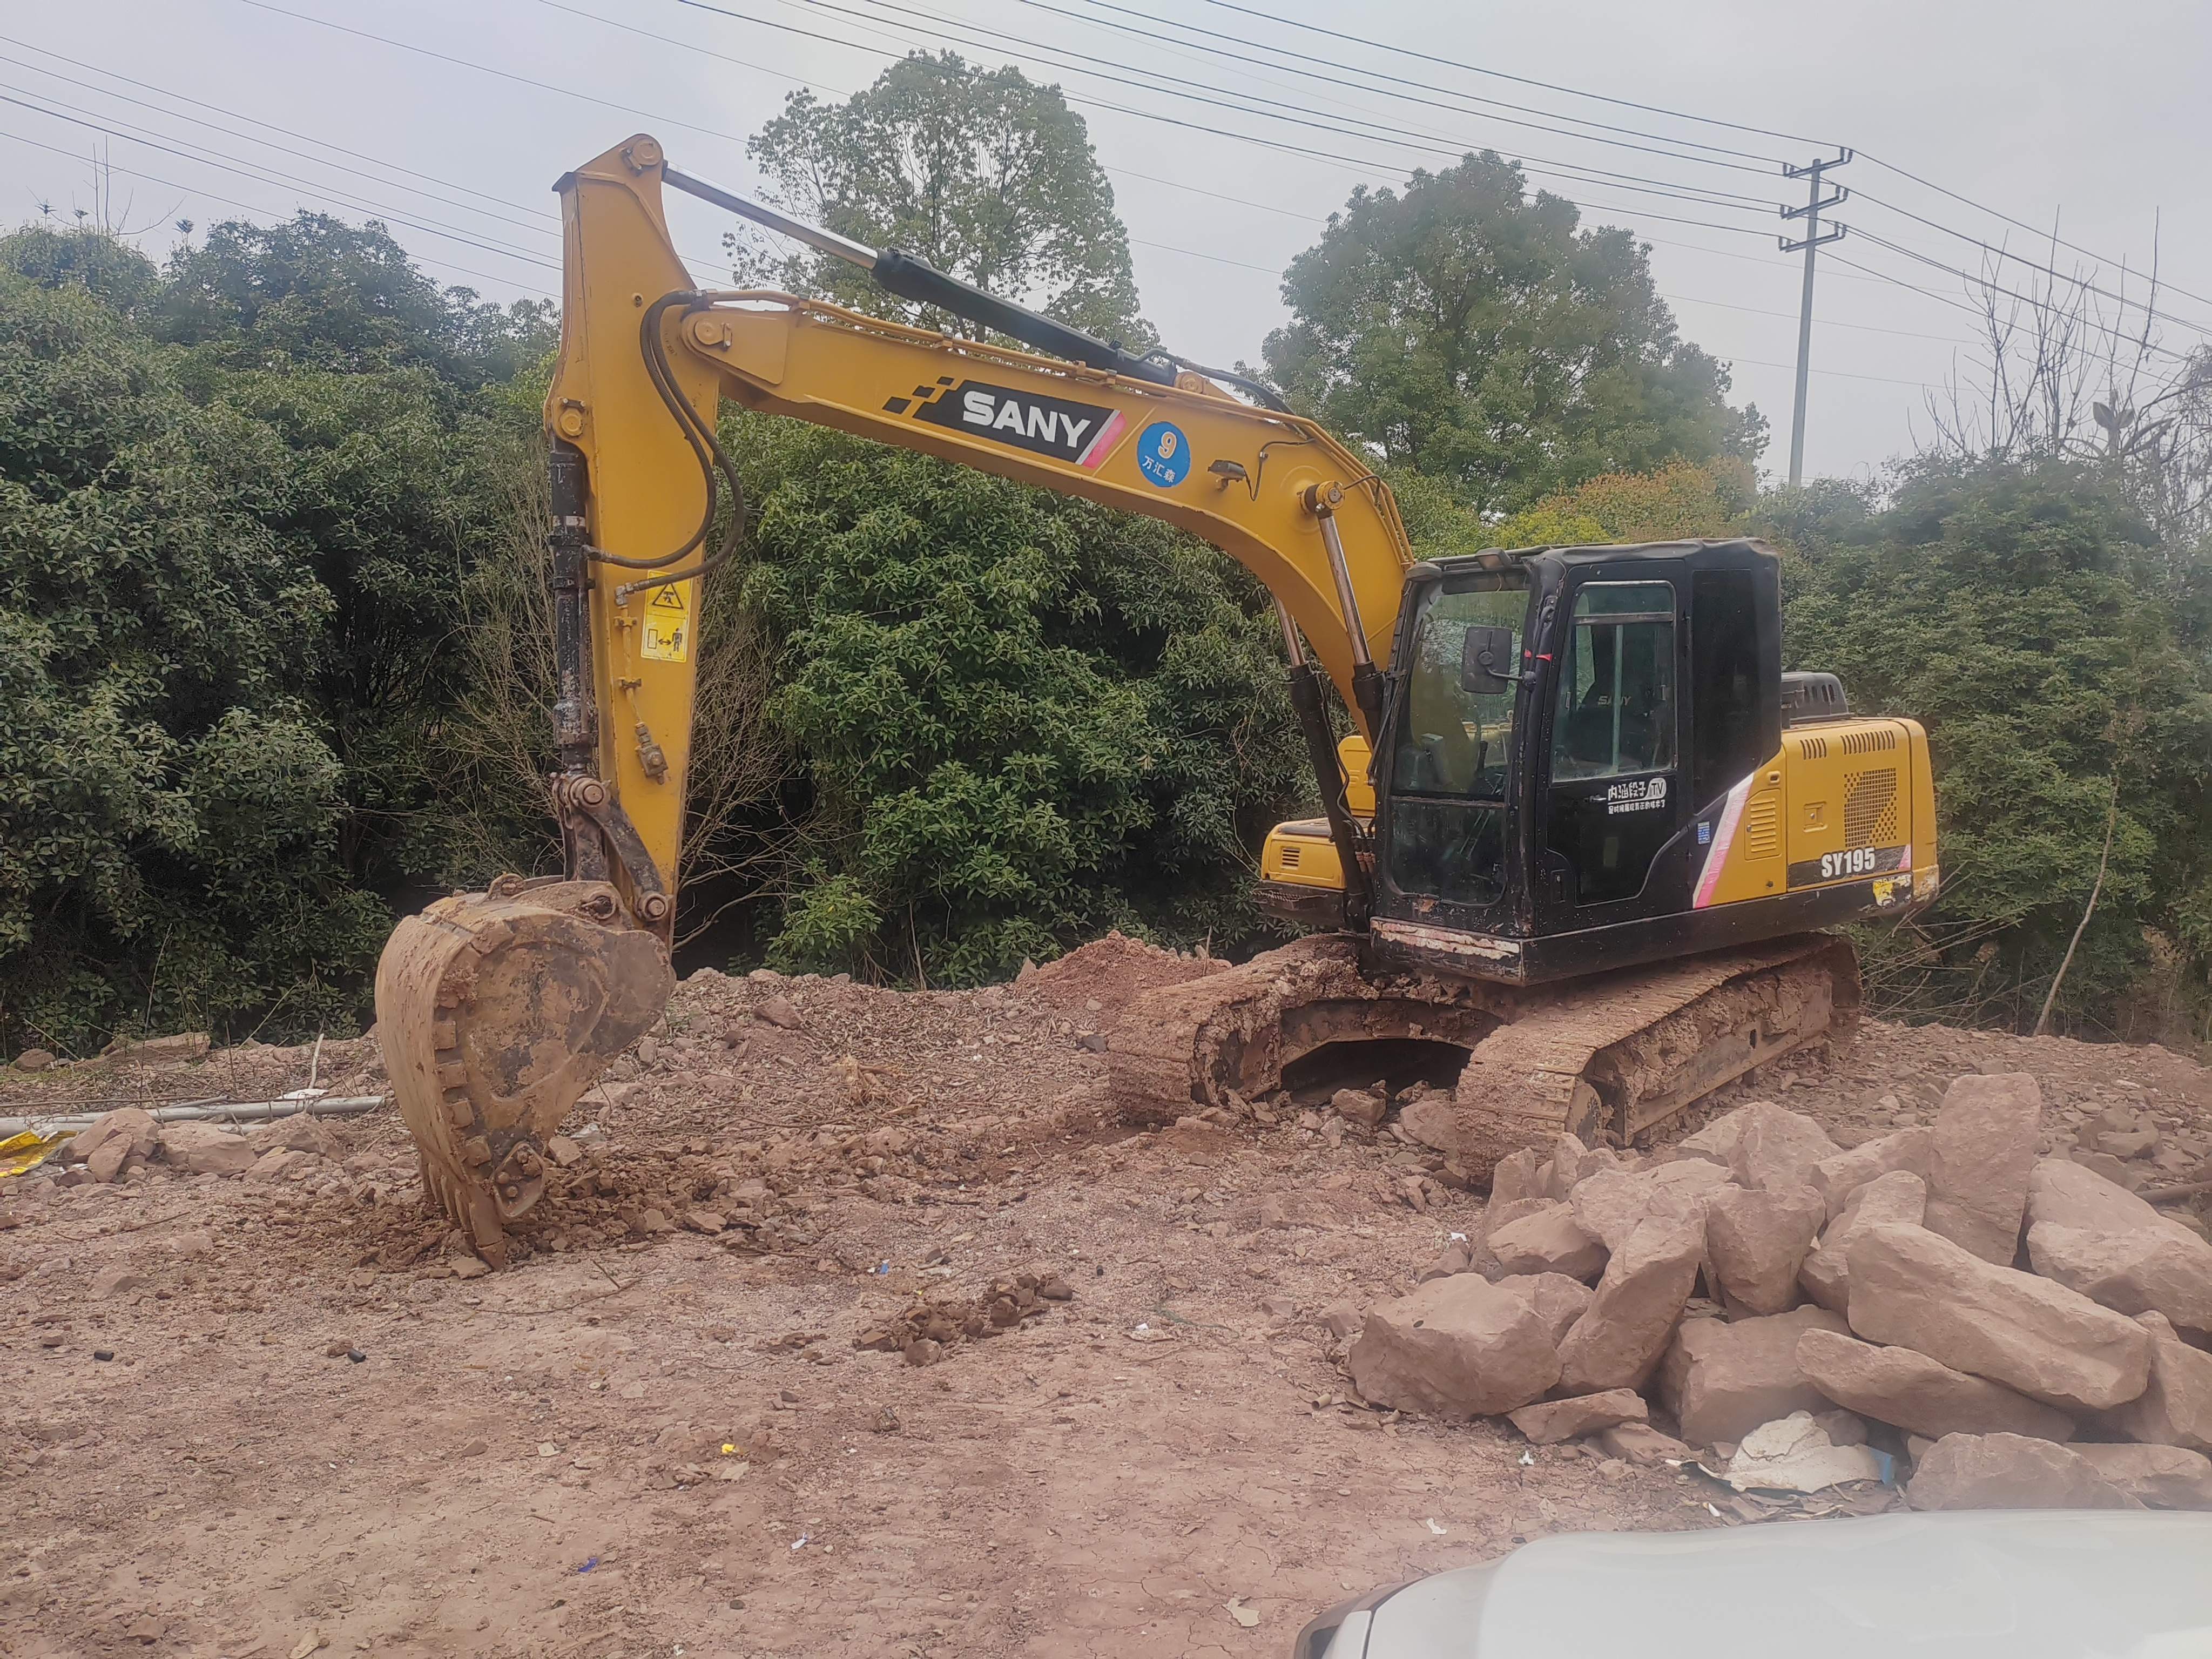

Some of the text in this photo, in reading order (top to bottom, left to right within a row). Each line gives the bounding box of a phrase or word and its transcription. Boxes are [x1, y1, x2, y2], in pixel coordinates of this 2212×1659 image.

[963, 390, 1091, 448] SANY
[1158, 431, 1177, 459] 9
[1142, 455, 1176, 483] 万汇森
[1651, 781, 1663, 795] TV
[1822, 847, 1876, 878] SY195
